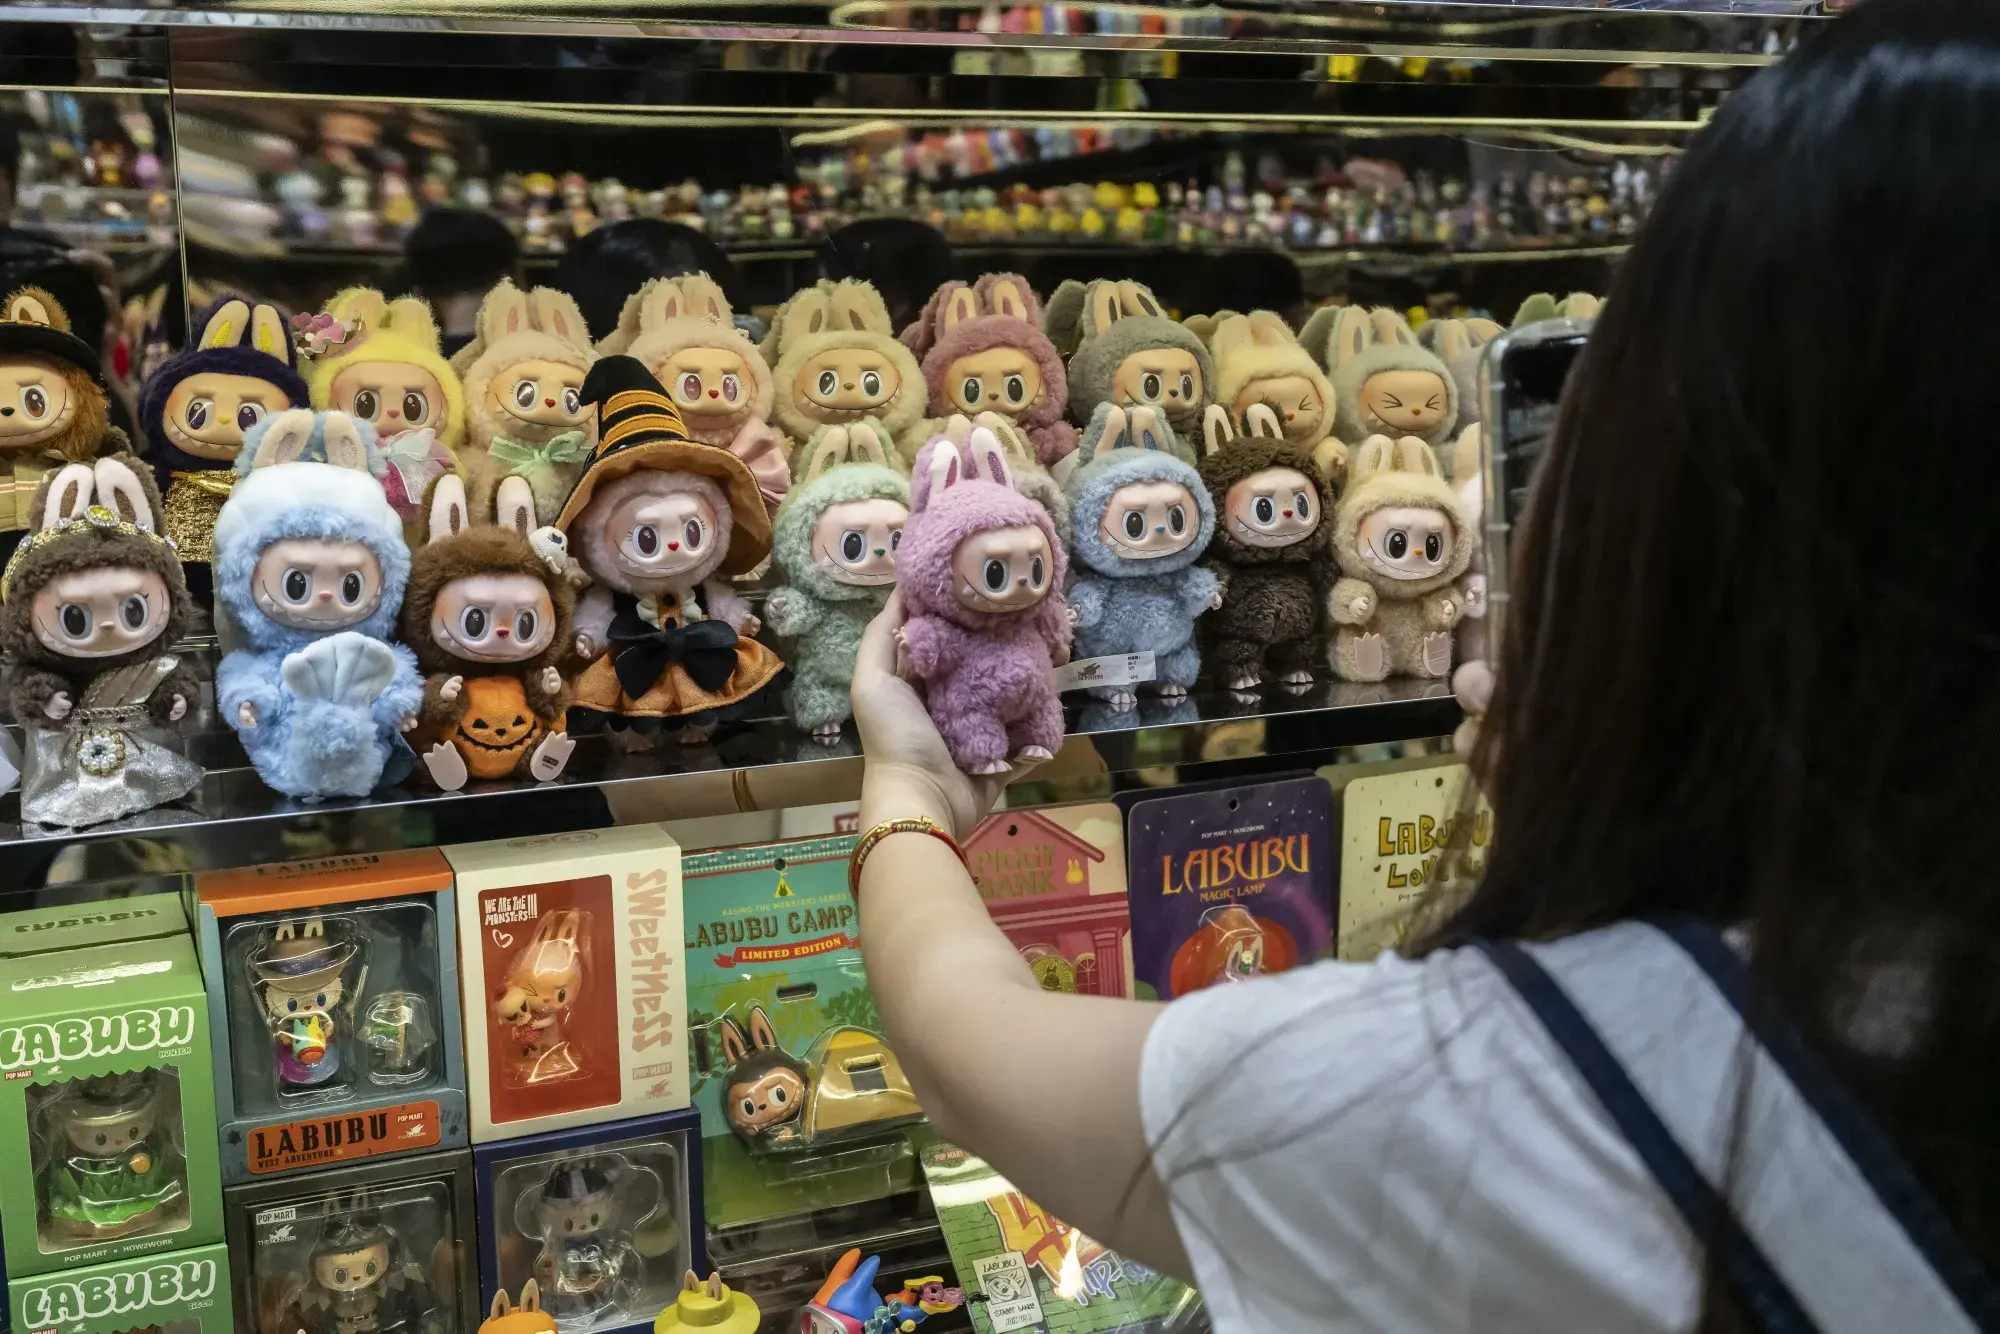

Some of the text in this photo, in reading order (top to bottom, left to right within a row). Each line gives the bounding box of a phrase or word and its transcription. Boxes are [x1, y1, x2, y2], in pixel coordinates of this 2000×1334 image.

[1378, 810, 1489, 857] LABUU
[973, 843, 1056, 875] PIGGY
[1162, 833, 1310, 896] LABUBU
[977, 868, 1058, 899] BANK
[1200, 883, 1266, 903] MAGIC LAMP
[485, 899, 497, 914] WE
[498, 897, 512, 913] ARE
[513, 895, 527, 911] THE
[755, 903, 771, 912] THE
[773, 897, 817, 910] MONSTERS
[787, 904, 859, 935] CAMP
[741, 937, 842, 961] LIMITED EDITION
[0, 1006, 195, 1069] LABUBU
[5, 1072, 17, 1080] POP
[17, 1070, 32, 1078] MART
[633, 1063, 671, 1079] POP MART
[397, 1112, 424, 1123] POP MART
[255, 1112, 388, 1160] LABUBU
[257, 1149, 335, 1168] WEST ADVENTURE
[934, 1149, 963, 1161] POP MART
[258, 1209, 295, 1223] POP MART
[64, 1254, 81, 1263] POP
[83, 1249, 108, 1260] MART
[123, 1238, 174, 1254] HOW2WORK
[983, 1258, 1017, 1273] LABUBU
[23, 1259, 217, 1329] LABUBU
